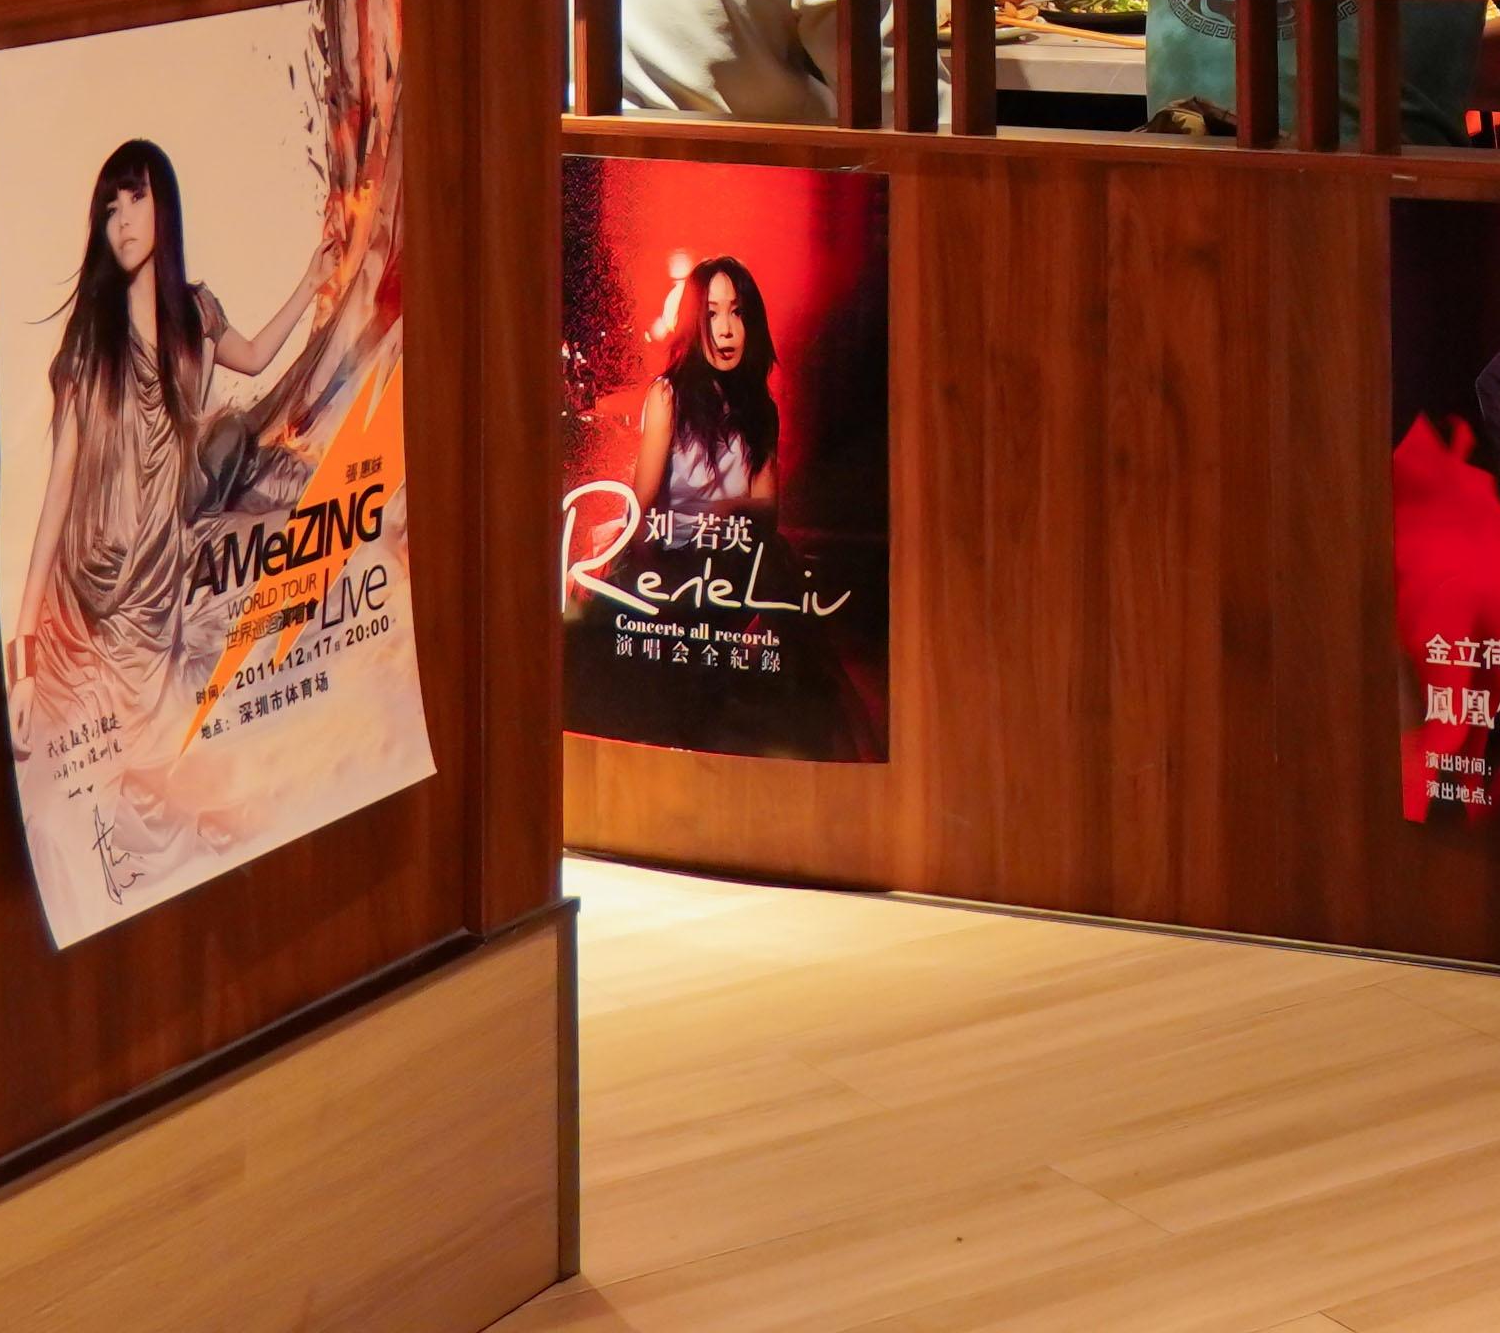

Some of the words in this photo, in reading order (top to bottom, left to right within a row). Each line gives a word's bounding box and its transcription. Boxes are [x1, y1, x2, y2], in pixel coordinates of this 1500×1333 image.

[226, 586, 278, 621] WORLD
[280, 572, 318, 602] TOUR
[345, 614, 390, 648] 20:00
[615, 613, 686, 638] Concerts
[689, 623, 710, 641] all
[715, 630, 781, 647] records
[239, 669, 331, 726] 深圳市体育场
